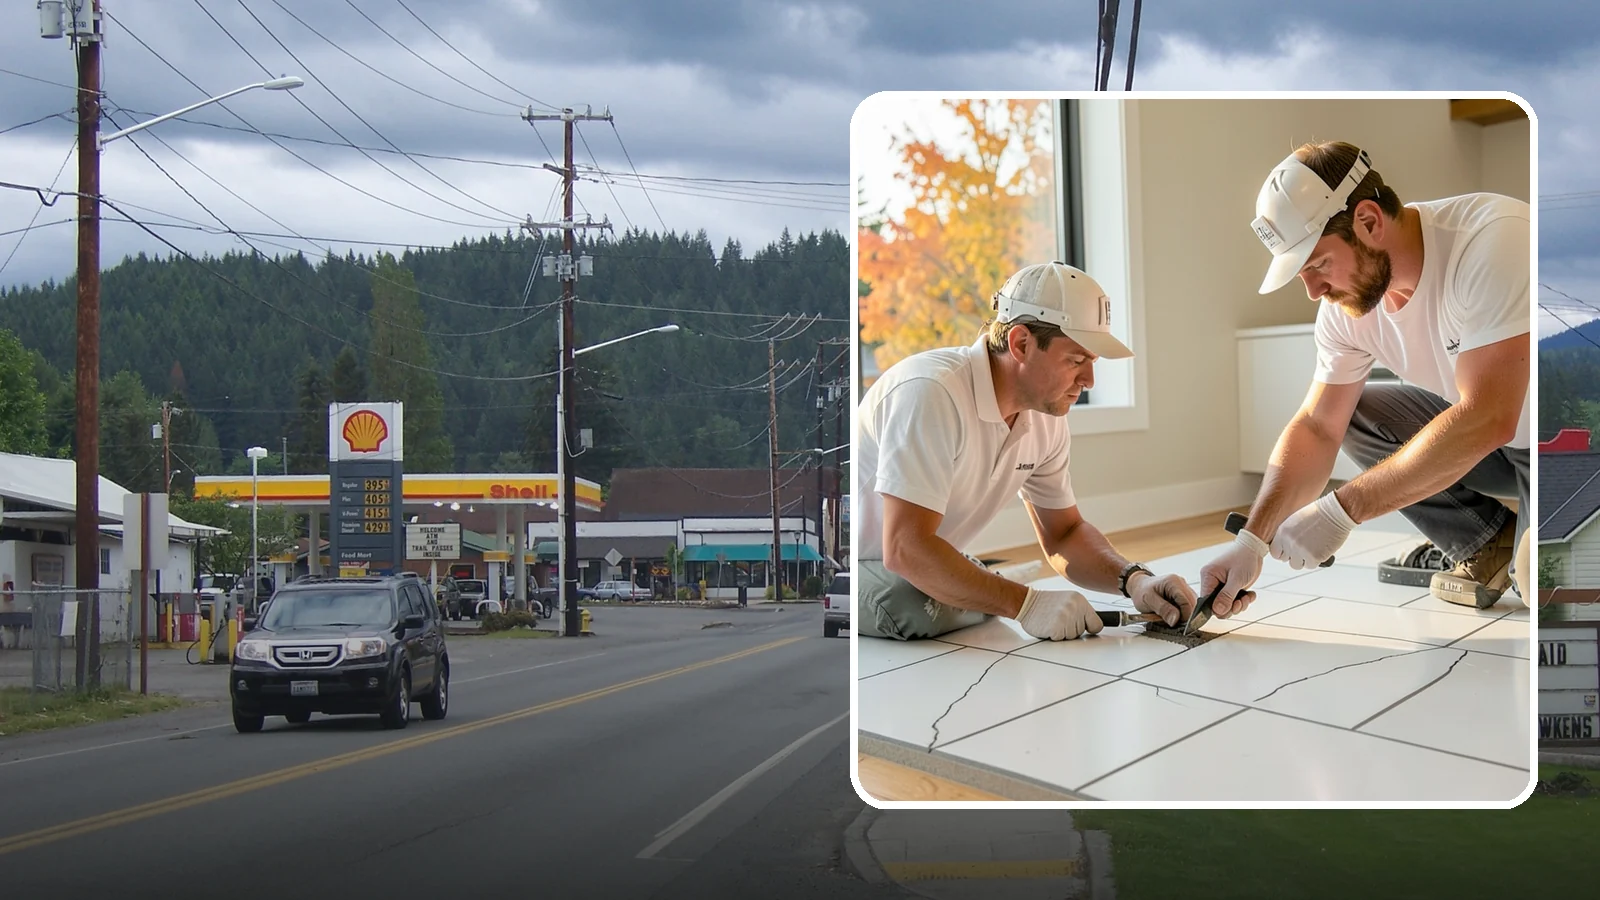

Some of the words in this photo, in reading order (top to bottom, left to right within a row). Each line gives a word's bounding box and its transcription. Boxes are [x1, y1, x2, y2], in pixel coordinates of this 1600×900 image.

[365, 480, 383, 490] 395
[490, 484, 548, 499] Shell
[365, 494, 383, 504] 405
[365, 508, 383, 518] 415
[365, 522, 383, 532] 429
